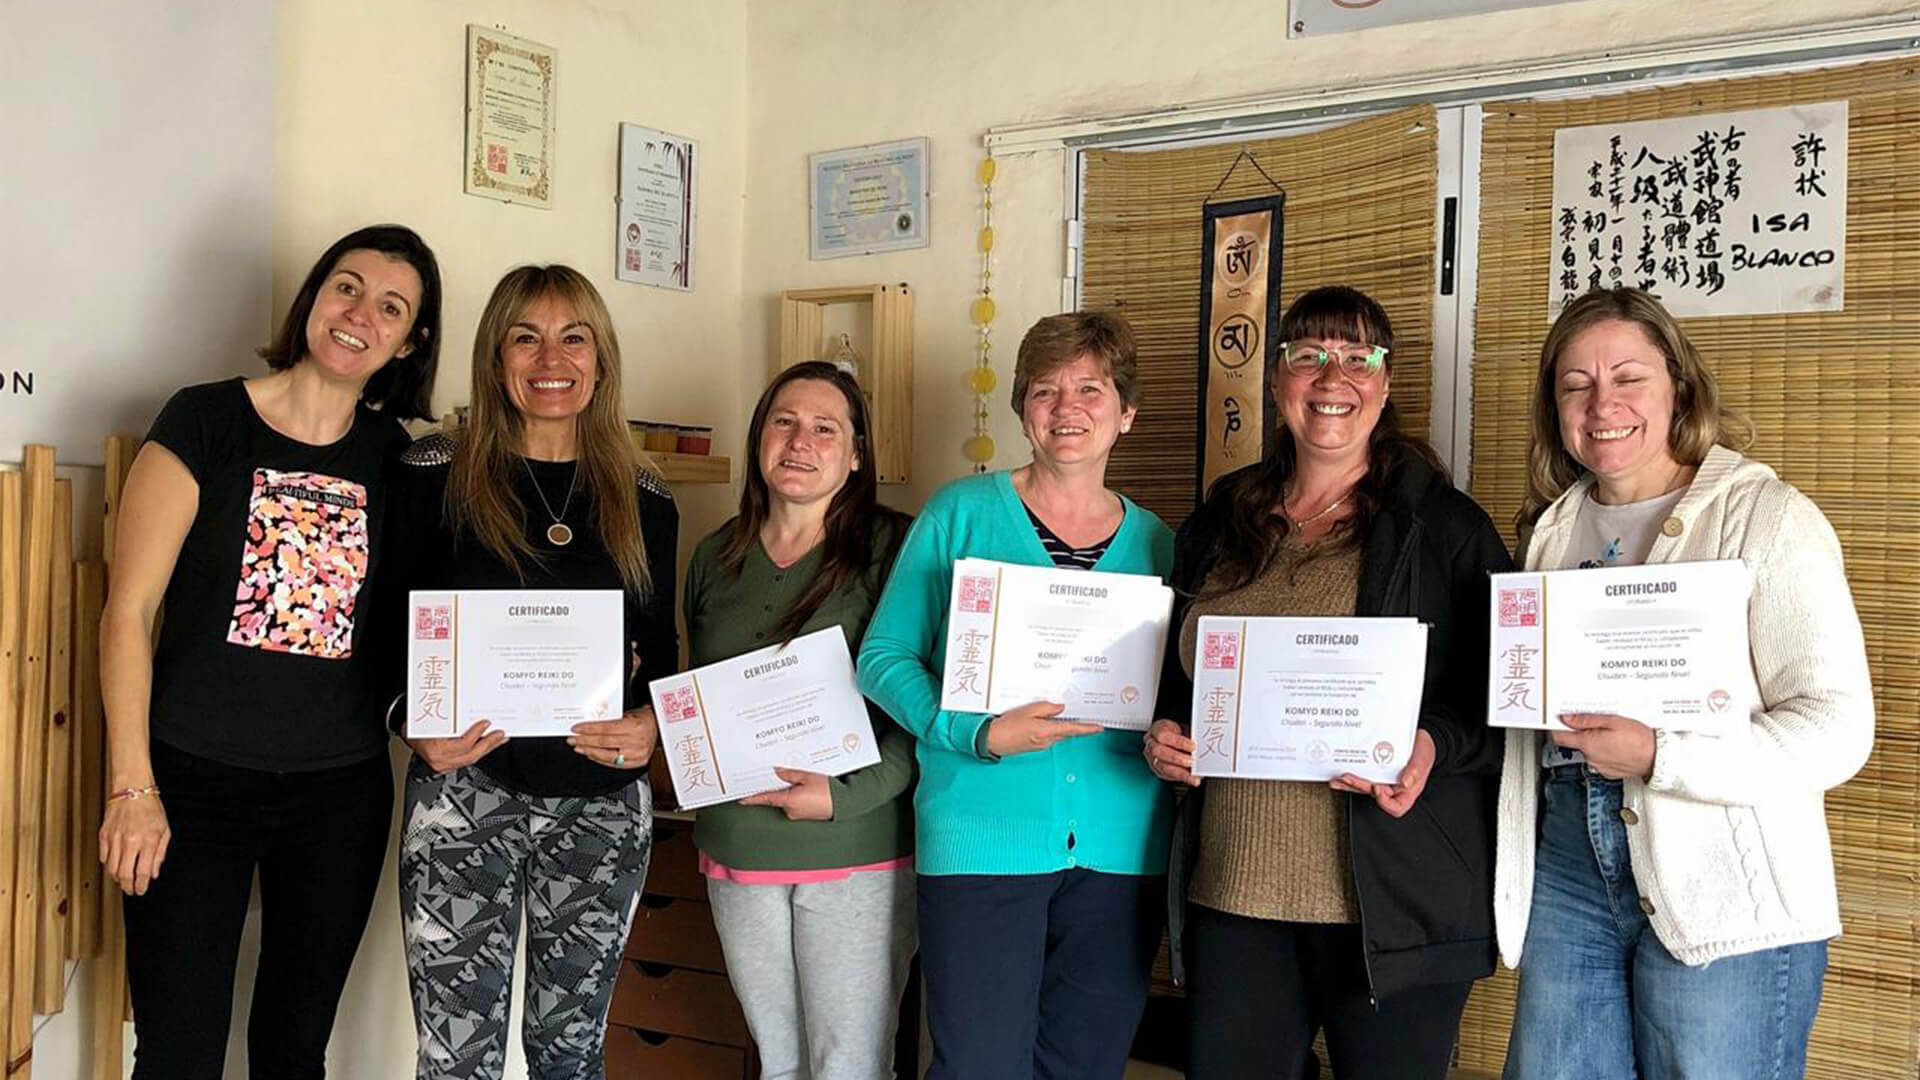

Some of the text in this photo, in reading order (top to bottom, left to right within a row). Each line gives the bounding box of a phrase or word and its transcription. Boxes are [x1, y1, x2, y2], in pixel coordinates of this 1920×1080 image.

[1752, 213, 1810, 234] ISA
[1731, 244, 1834, 271] BLANCO
[1049, 584, 1108, 599] CERTIFICADO
[1604, 581, 1677, 597] CERTIFICADO
[508, 606, 570, 616] CERTIFICADO
[1296, 634, 1359, 646] CERTIFICADO
[744, 655, 799, 680] CERTIFICADO
[1600, 658, 1687, 669] KOMYO REIKI DO
[1285, 706, 1359, 717] KOMYO REIKI DO
